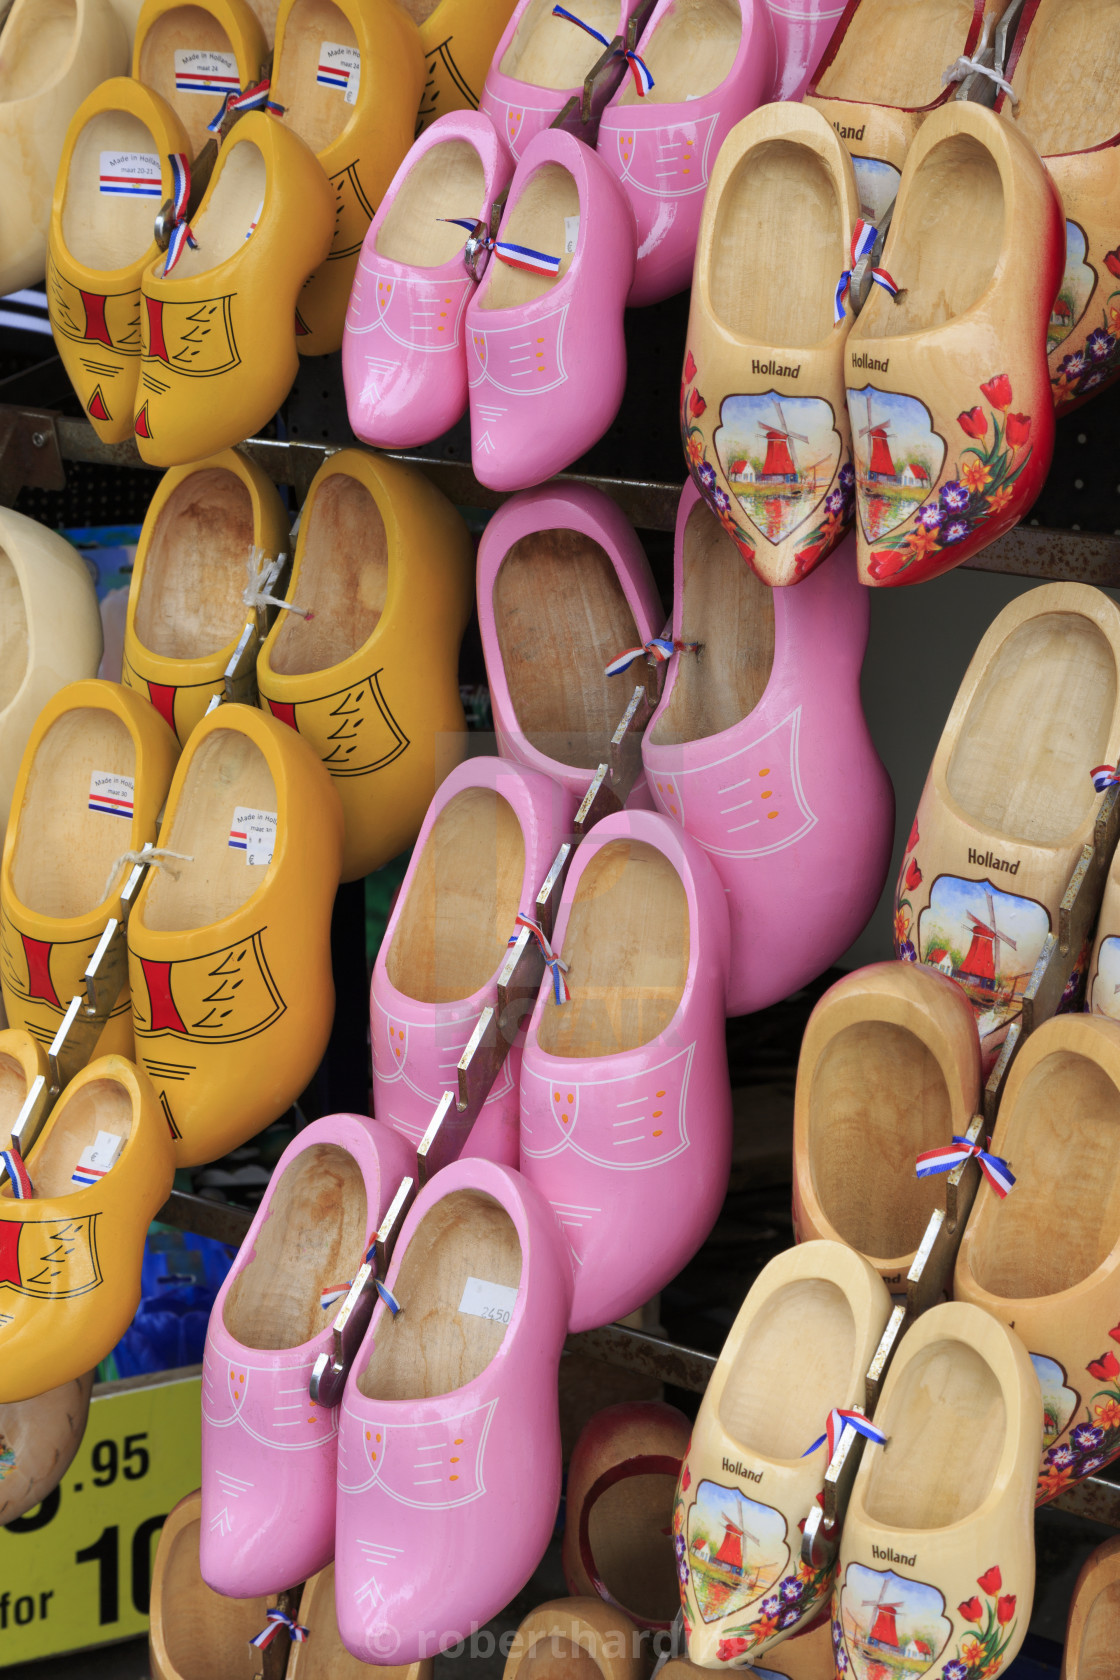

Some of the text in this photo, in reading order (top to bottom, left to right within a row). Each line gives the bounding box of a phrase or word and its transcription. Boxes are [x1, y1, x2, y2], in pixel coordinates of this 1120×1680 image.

[182, 53, 200, 65] Made
[209, 53, 232, 69] Holland
[327, 48, 345, 58] Made
[109, 155, 129, 167] Made
[752, 359, 801, 379] Holland
[851, 353, 890, 373] Holland
[95, 777, 112, 787] Made
[237, 813, 256, 824] Made
[968, 847, 1021, 875] Holland
[722, 1457, 764, 1484] Holland
[871, 1544, 917, 1567] Holland
[0, 1590, 54, 1630] for
